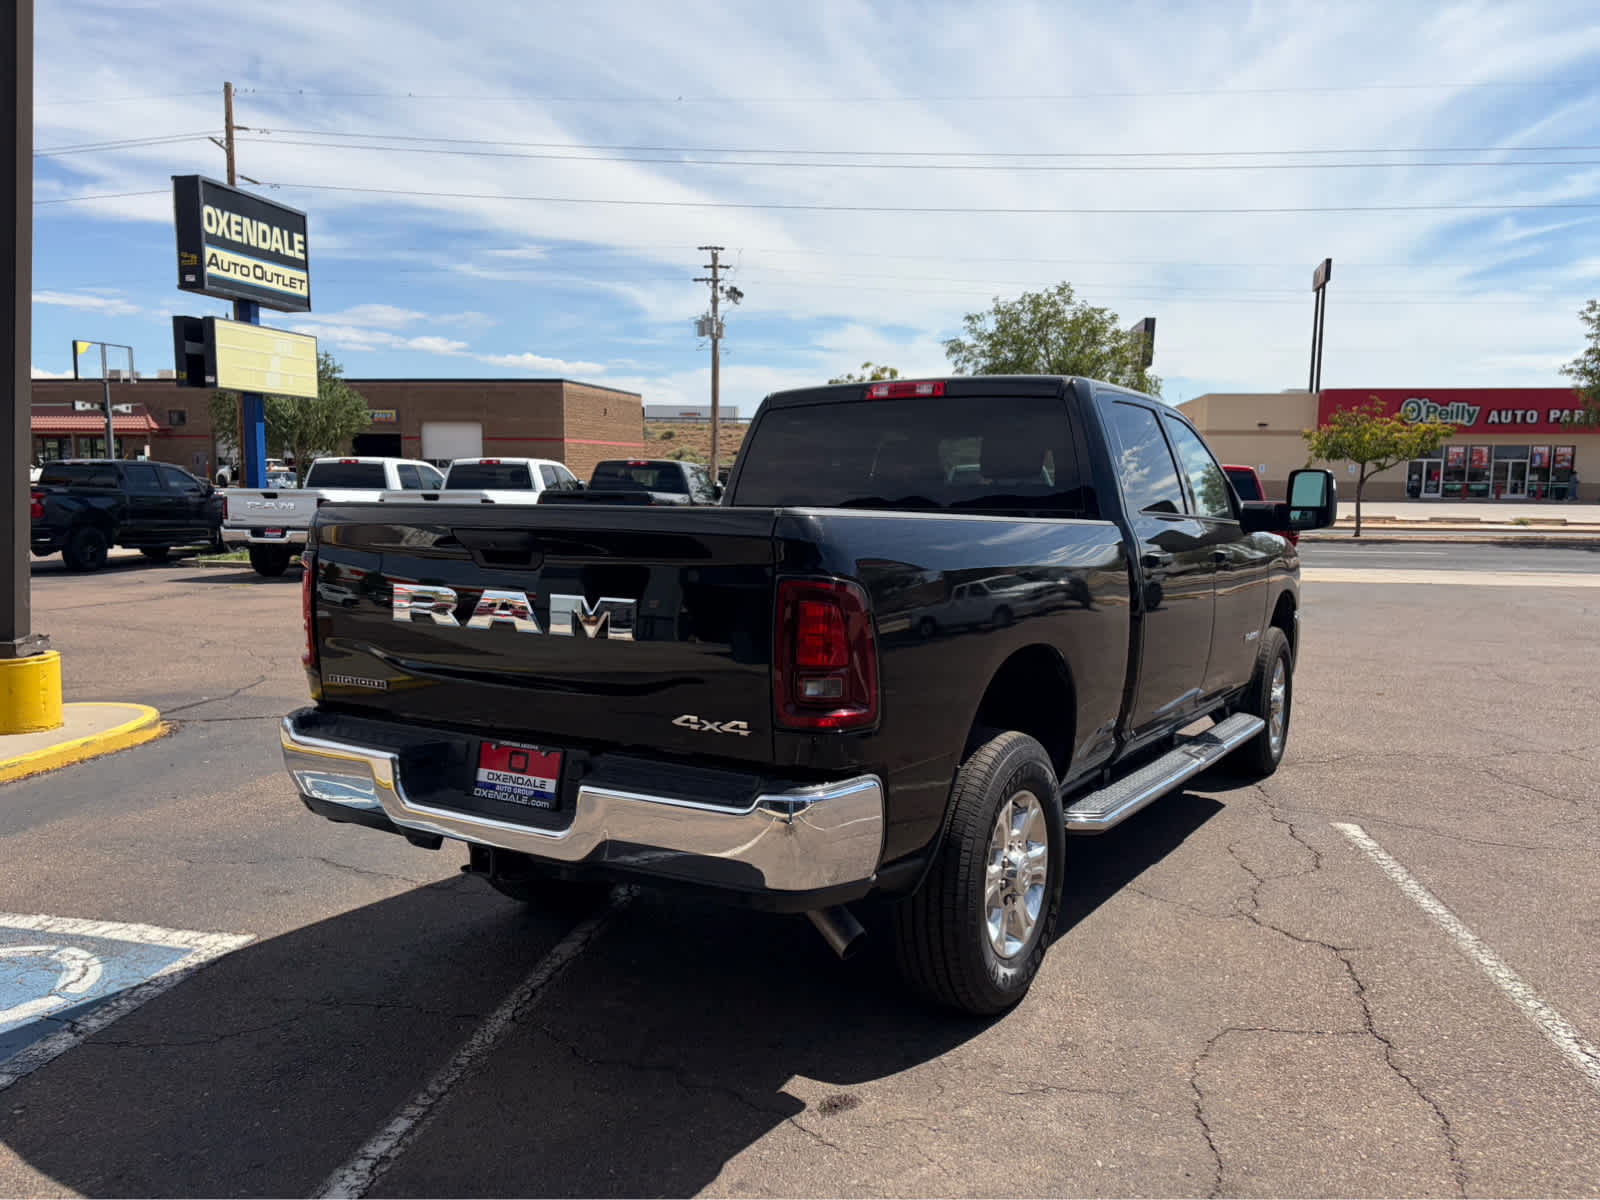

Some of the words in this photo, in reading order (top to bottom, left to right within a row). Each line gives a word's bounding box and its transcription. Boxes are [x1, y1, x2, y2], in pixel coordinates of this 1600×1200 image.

[203, 205, 305, 261] OXENDALE
[1487, 409, 1539, 424] AUTO
[1548, 409, 1590, 424] PAR
[393, 584, 637, 641] RAM
[487, 771, 547, 790] OXENDALE
[496, 785, 512, 793] AUTO
[474, 788, 549, 808] OXENDALE.com
